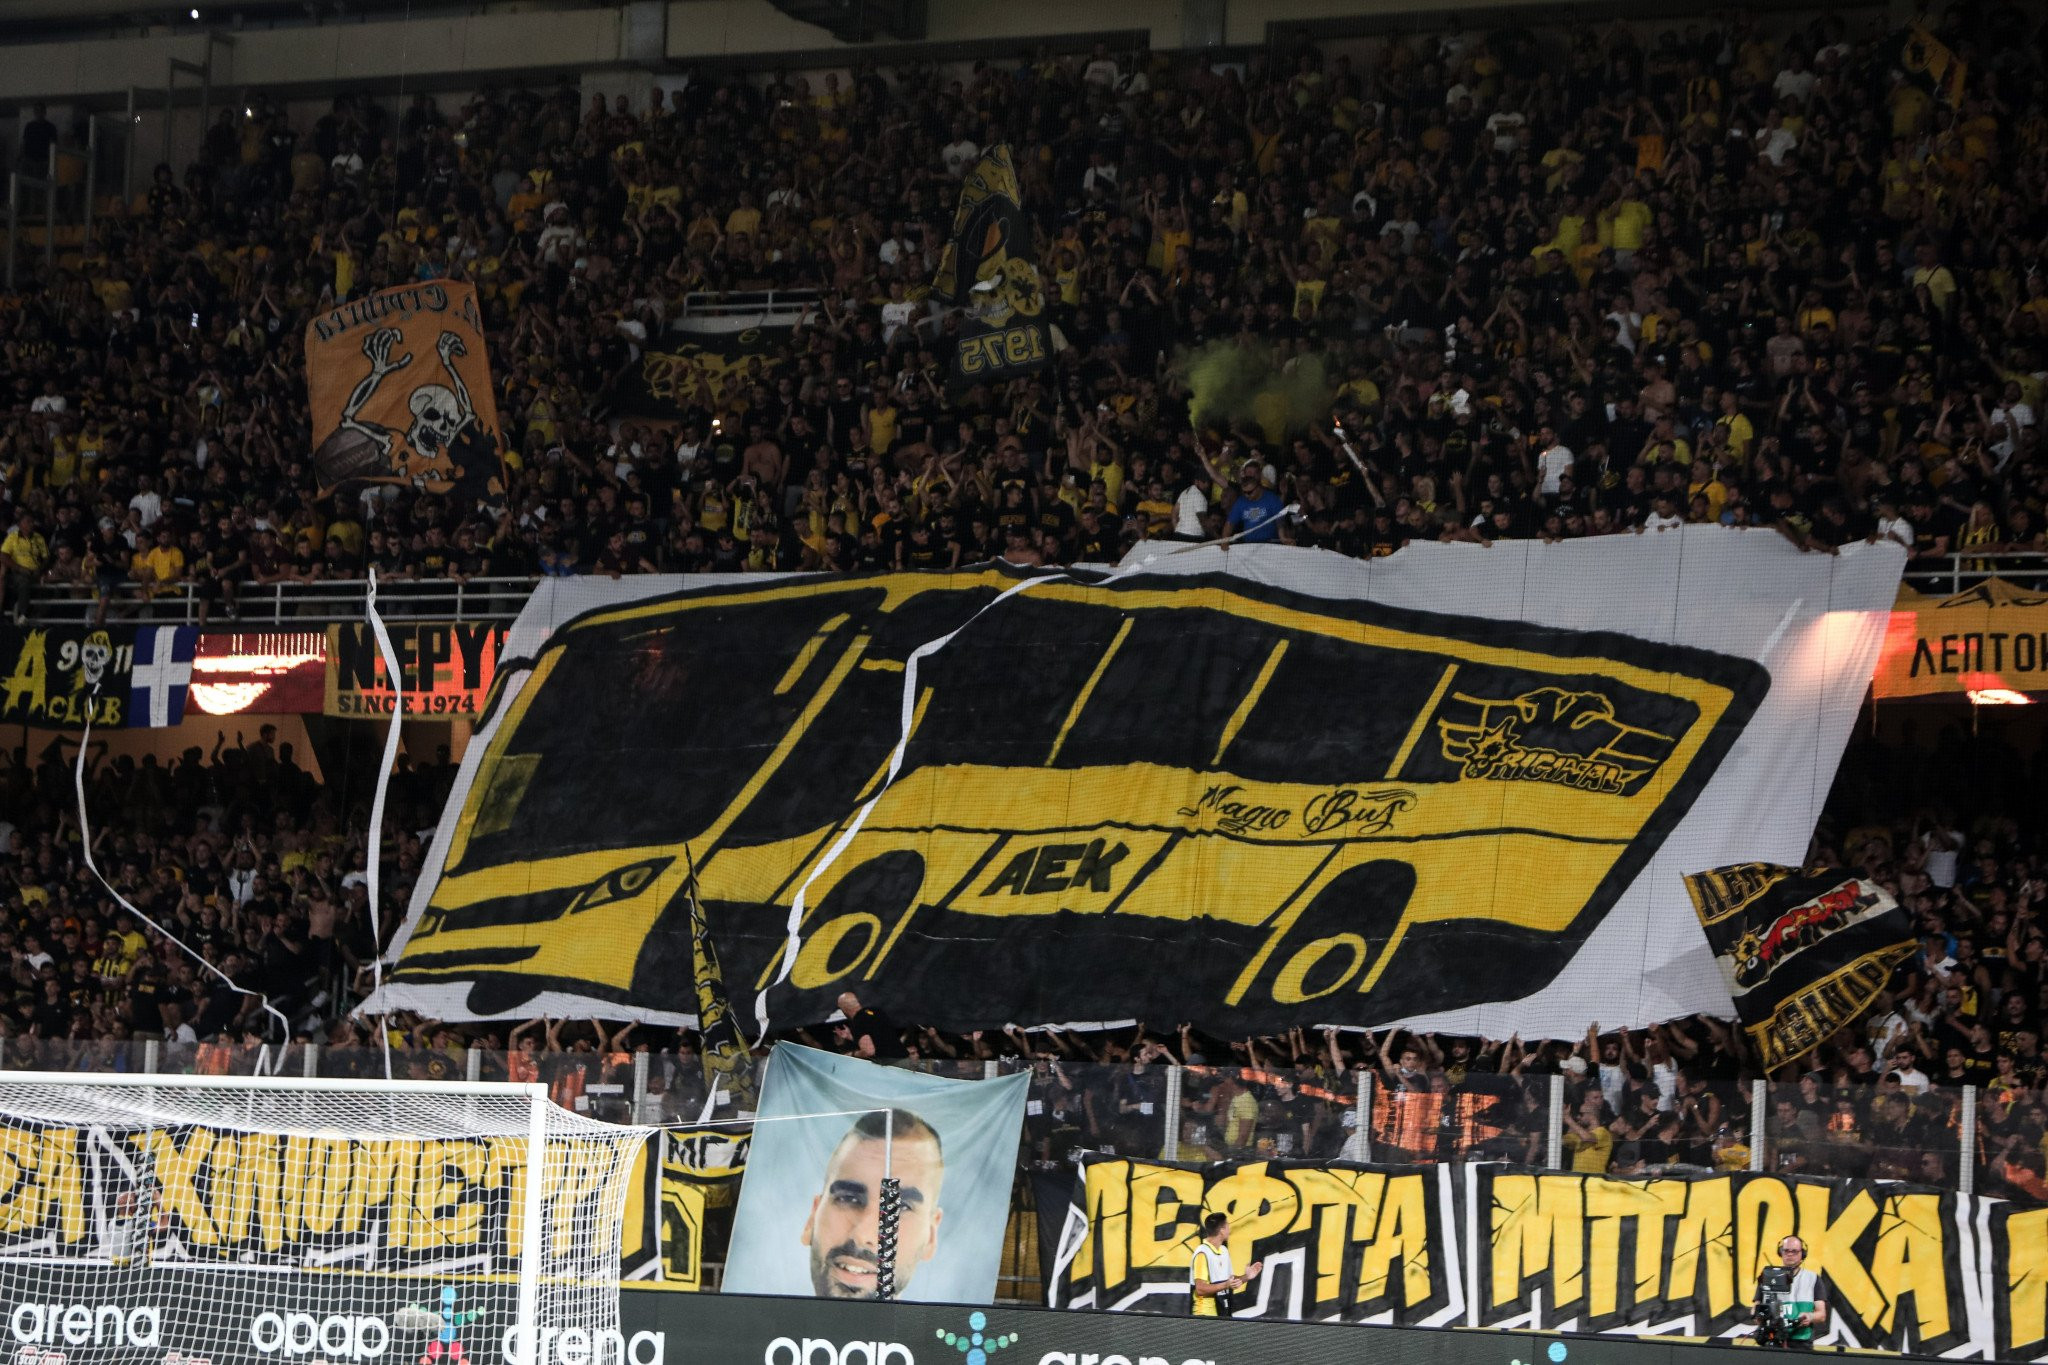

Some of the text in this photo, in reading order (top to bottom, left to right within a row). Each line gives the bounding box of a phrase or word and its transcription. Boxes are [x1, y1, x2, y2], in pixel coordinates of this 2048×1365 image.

[338, 694, 475, 714] SINCE 1974
[1178, 784, 1418, 838] Magic Bus
[1071, 1160, 1431, 1308] ΛΕΦΤΑ
[1492, 1175, 1950, 1341] ΜΠΛΟΚΑ
[11, 1302, 160, 1347] arena
[251, 1311, 389, 1361] opap
